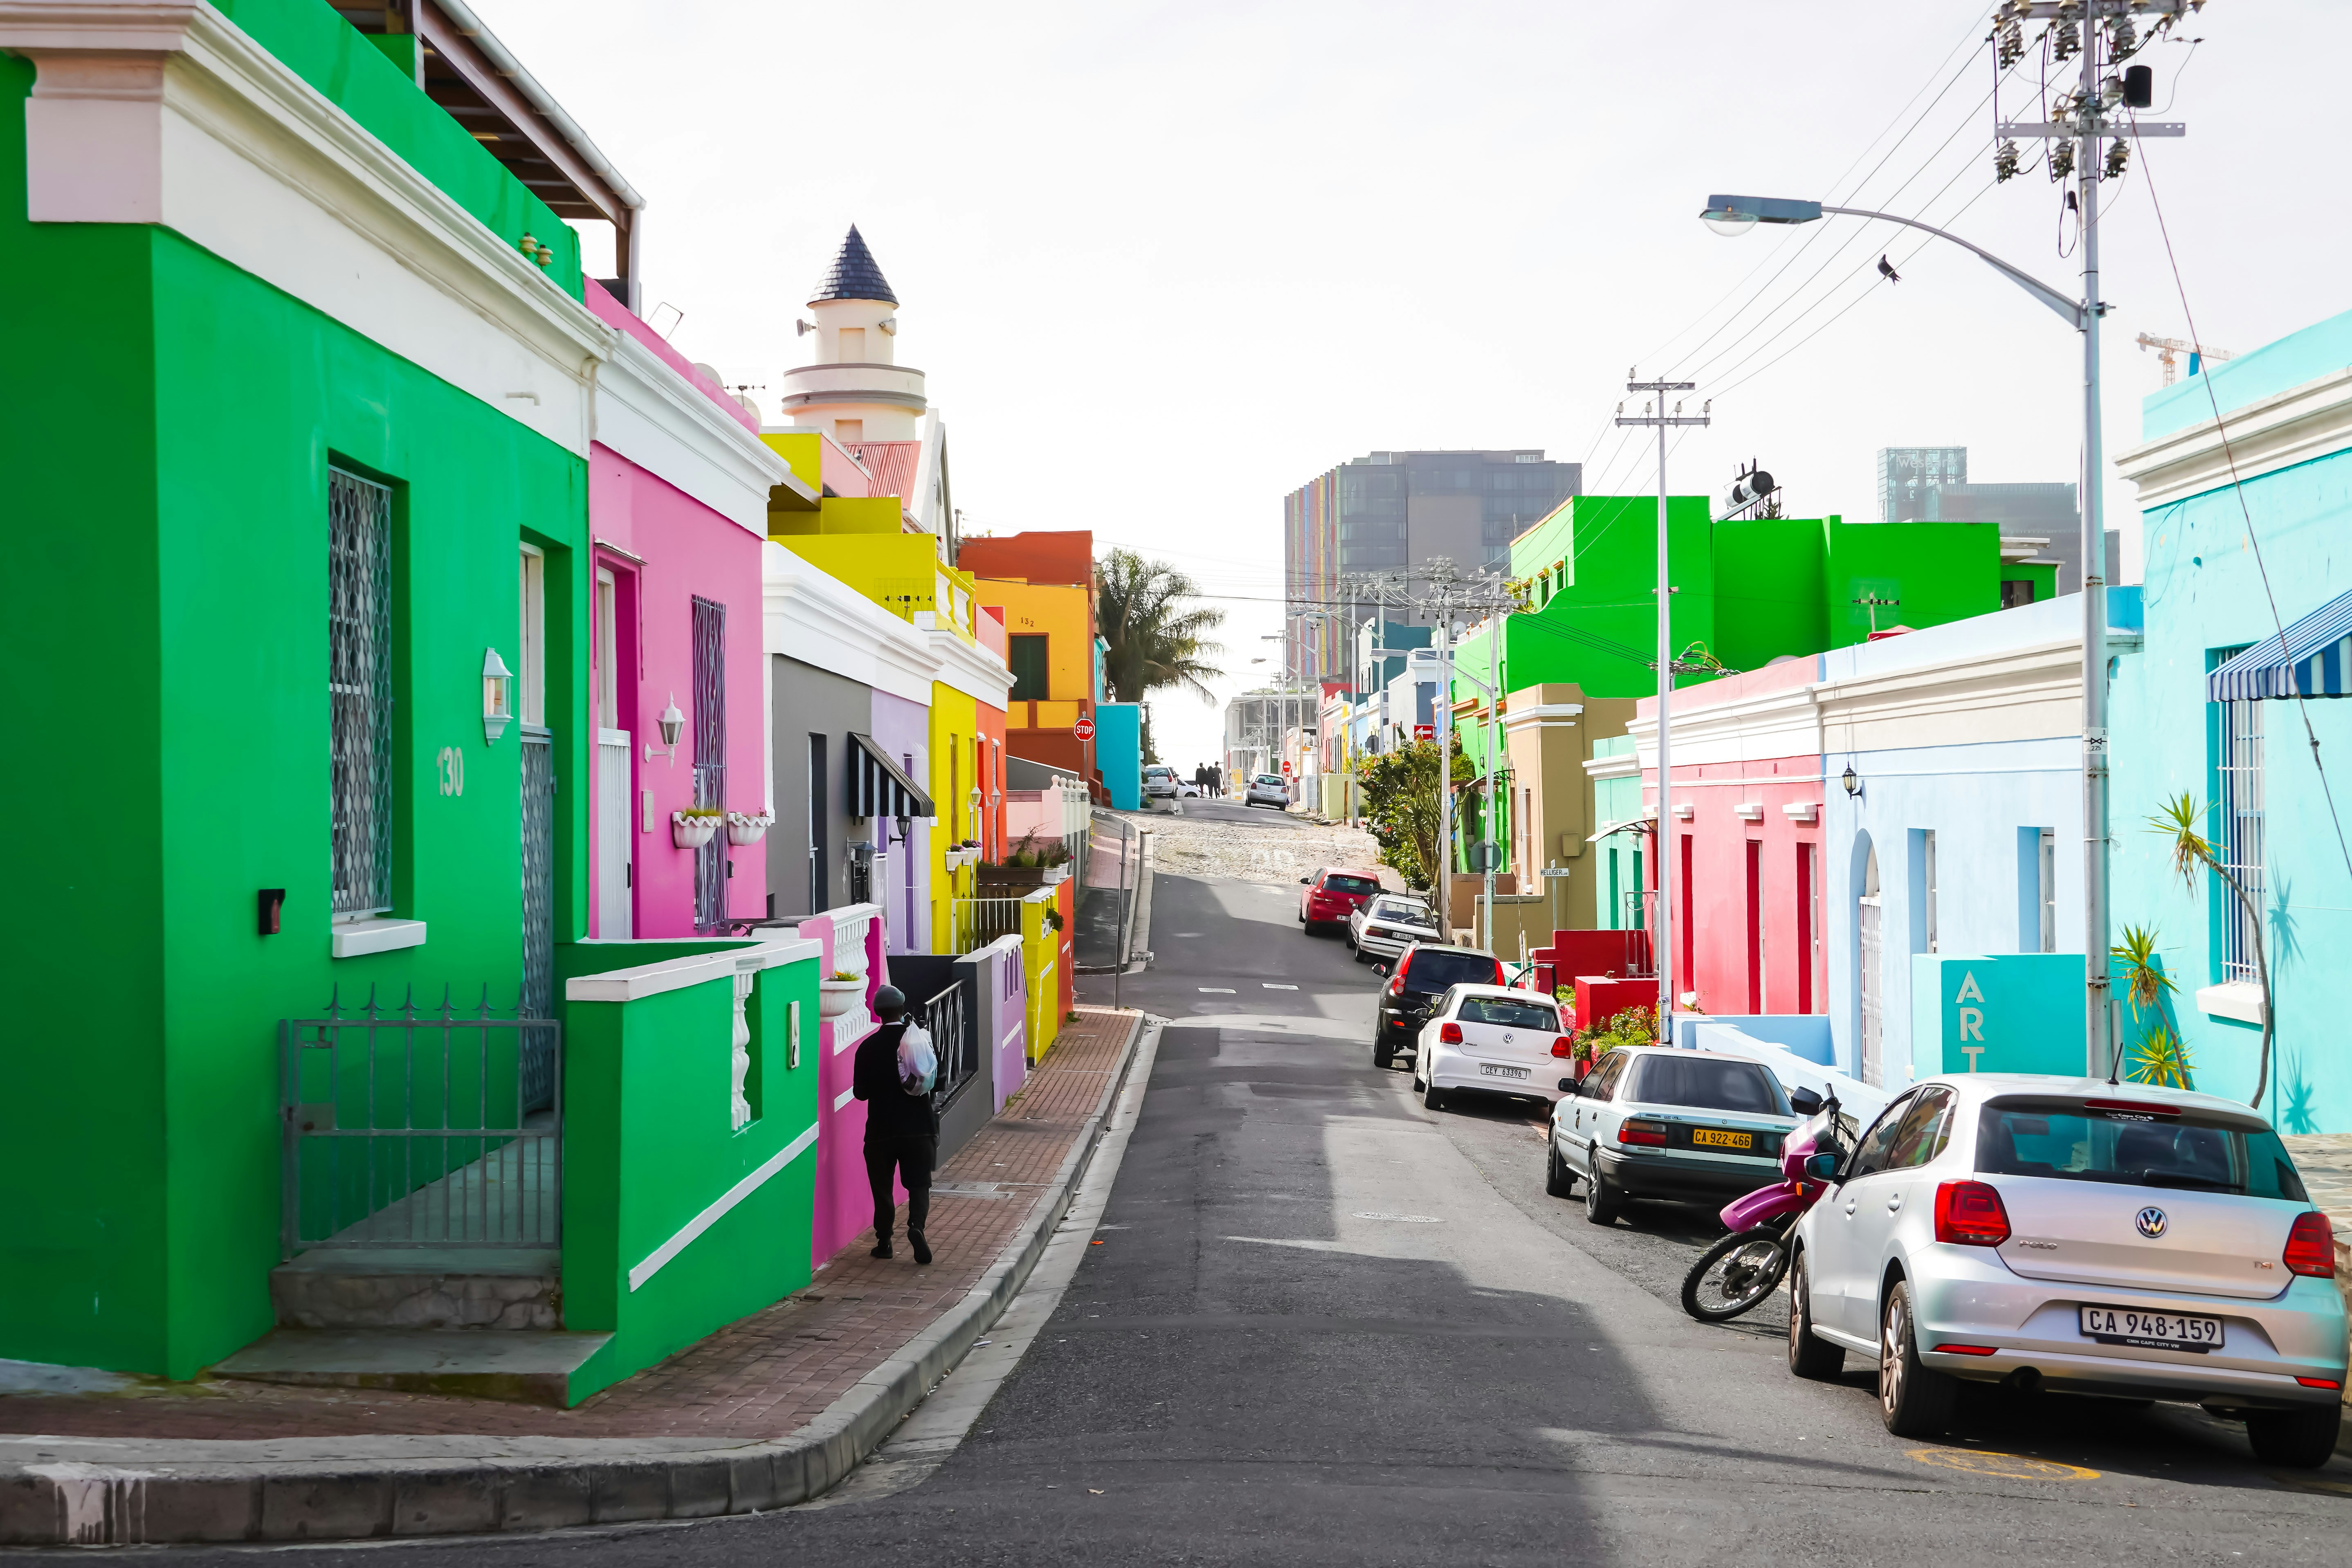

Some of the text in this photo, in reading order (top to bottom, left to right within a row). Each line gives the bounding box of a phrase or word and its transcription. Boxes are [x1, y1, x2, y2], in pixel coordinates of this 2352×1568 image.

[1020, 617, 1034, 627] 132
[1076, 725, 1093, 735] STOP
[436, 746, 464, 797] 130
[1955, 970, 1985, 1073] ART
[1502, 1069, 1522, 1077] 63396
[1695, 1131, 1750, 1146] CA 922-466
[2020, 1240, 2058, 1249] POLO
[2090, 1310, 2216, 1341] CA 948-159
